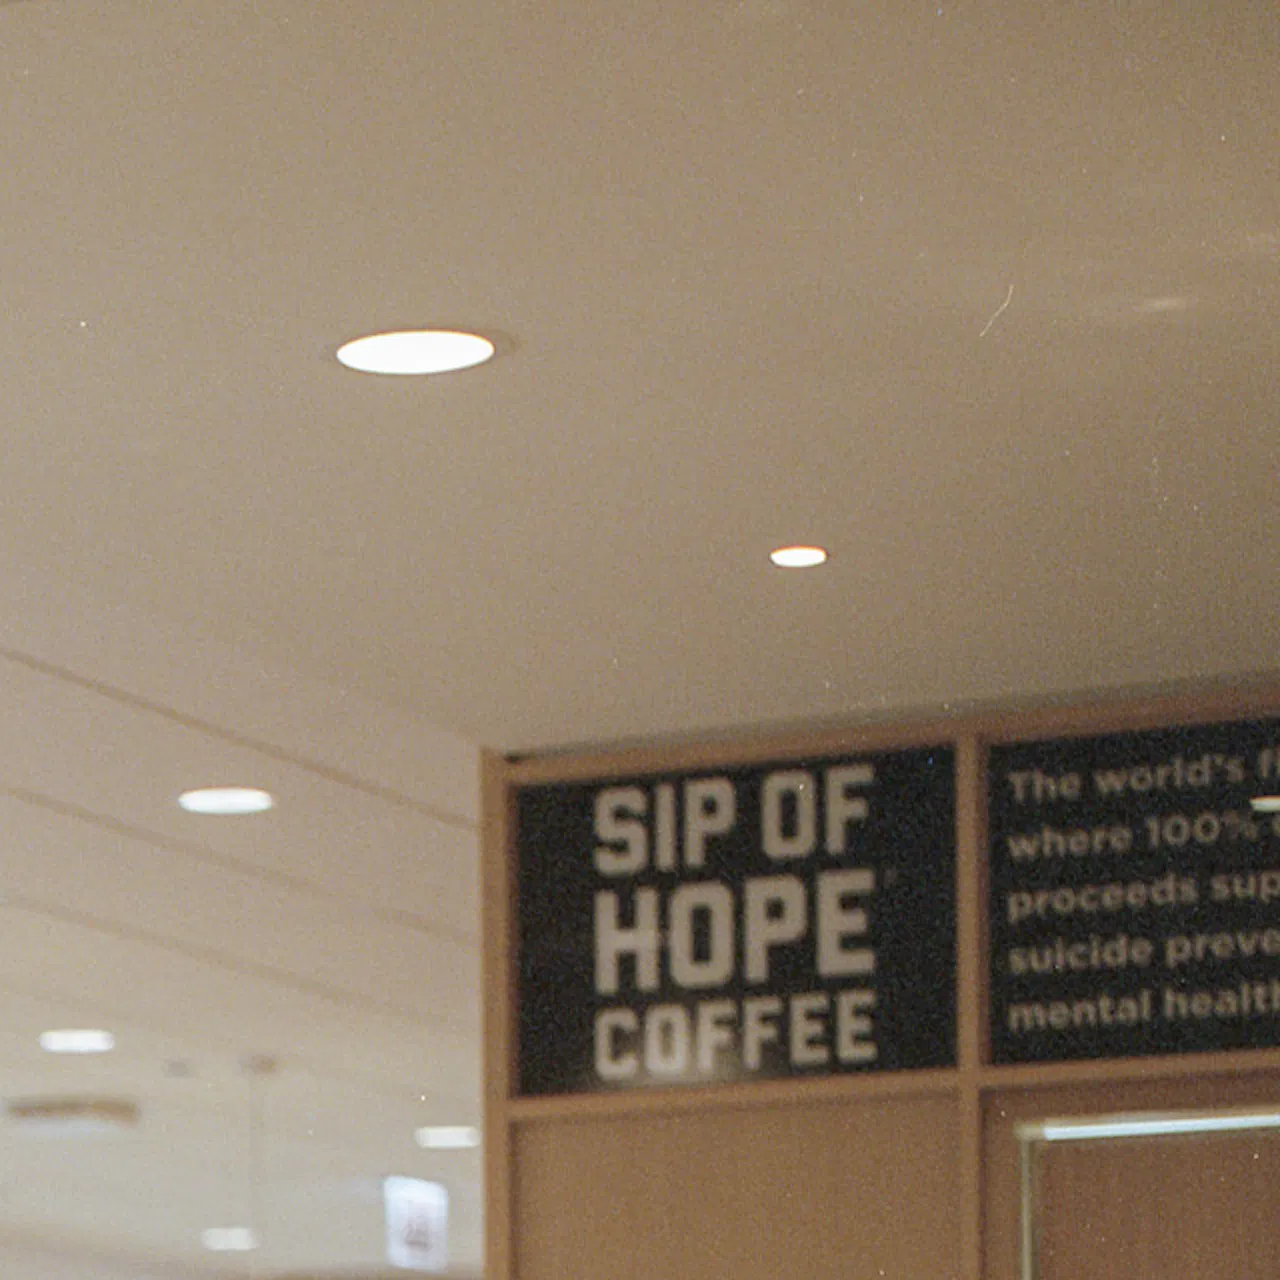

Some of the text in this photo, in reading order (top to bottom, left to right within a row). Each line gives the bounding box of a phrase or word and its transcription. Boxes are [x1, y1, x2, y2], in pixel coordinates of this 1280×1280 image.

[1007, 768, 1082, 803] The
[1093, 753, 1245, 794] world's
[594, 763, 875, 878] SIP OF
[1006, 825, 1134, 859] where
[1144, 809, 1260, 847] 100%
[1007, 872, 1199, 924] proceeds
[593, 868, 876, 995] HOPE
[1007, 933, 1154, 974] suicide
[593, 989, 878, 1081] COFFEE
[1007, 987, 1152, 1032] mental
